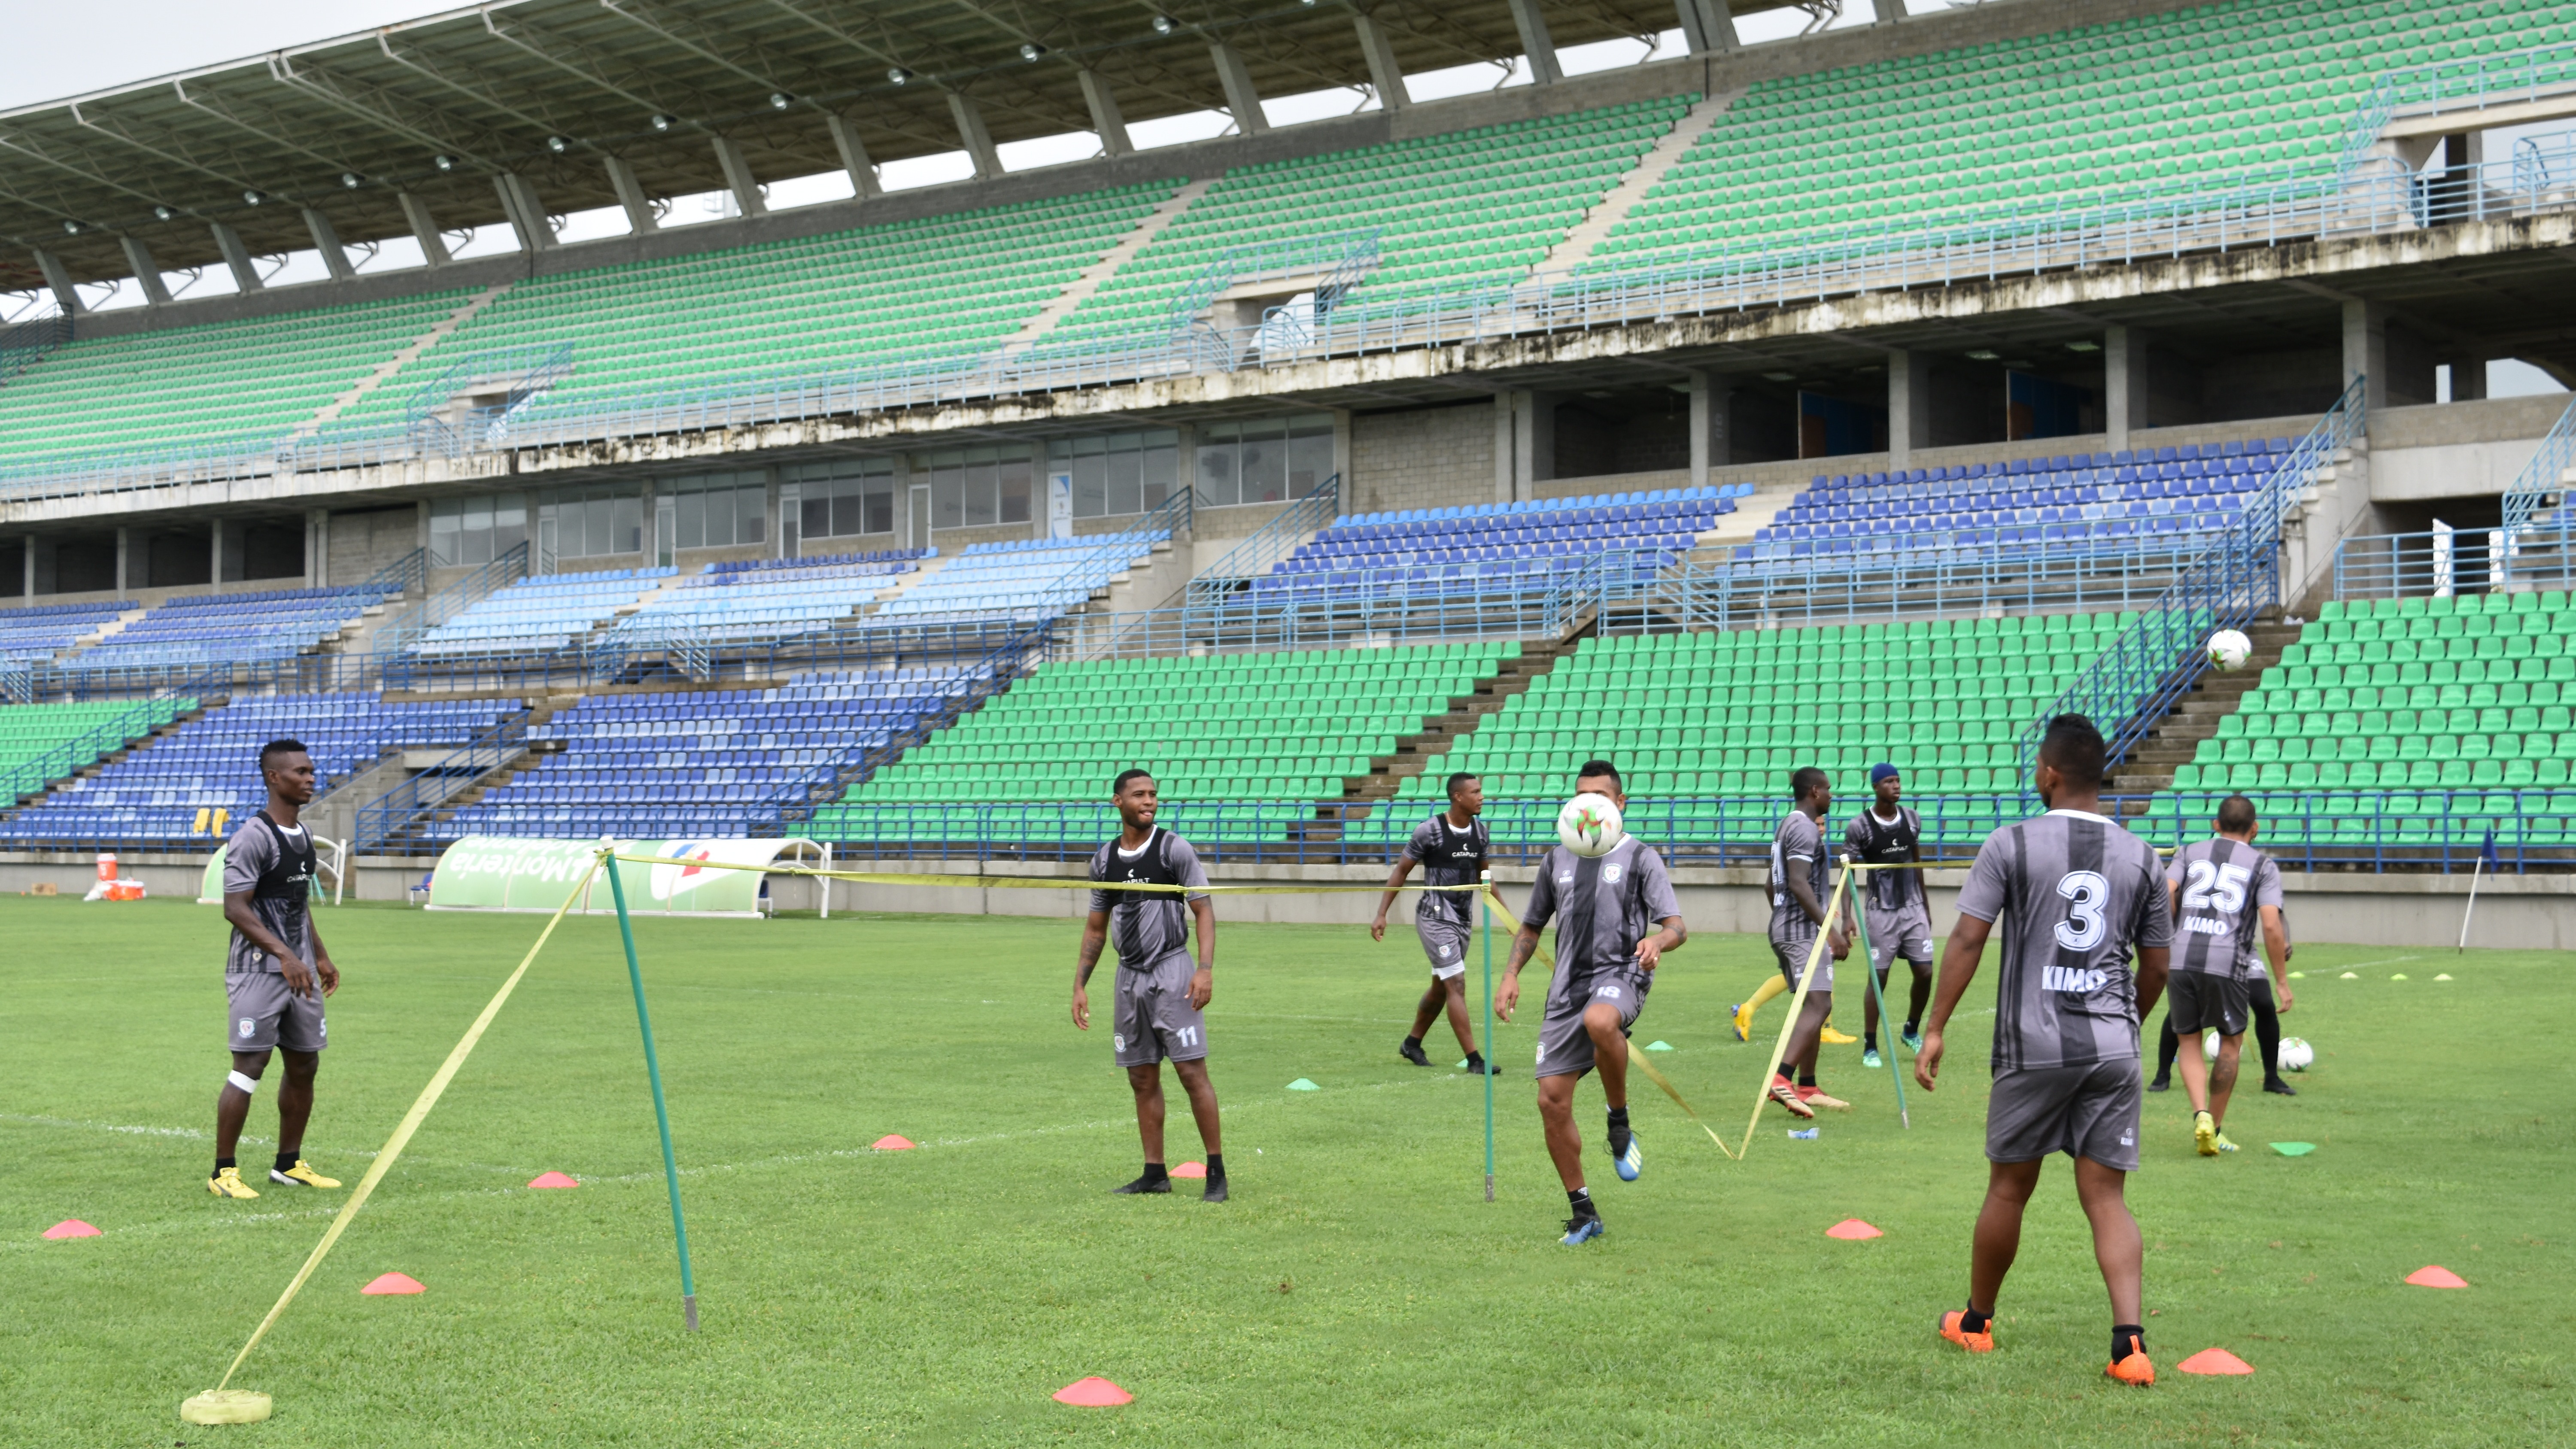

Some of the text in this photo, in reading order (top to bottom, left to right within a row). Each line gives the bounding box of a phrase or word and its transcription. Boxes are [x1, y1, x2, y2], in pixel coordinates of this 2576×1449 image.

[2182, 859, 2251, 913] 25
[2054, 870, 2110, 951] 3
[2182, 915, 2229, 935] KIMO
[2041, 966, 2108, 992] KIMO
[1596, 985, 1621, 999] 18
[1176, 1025, 1198, 1047] 11
